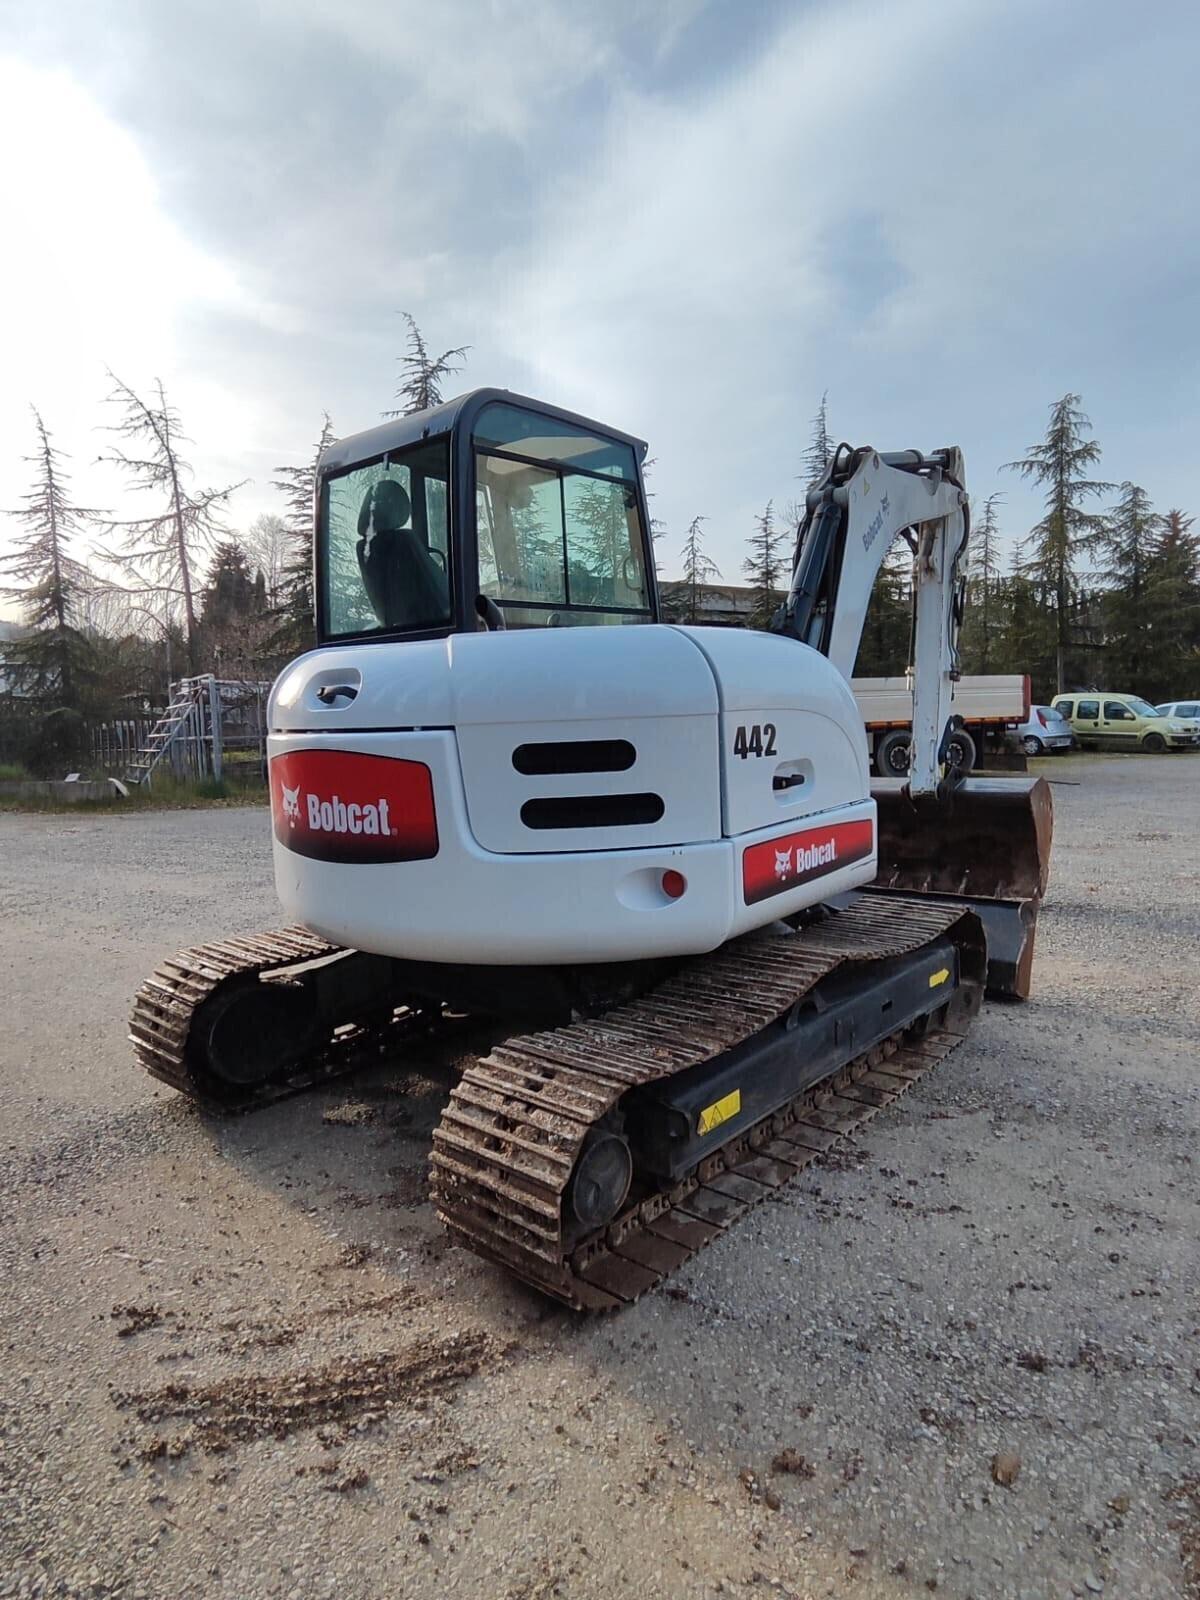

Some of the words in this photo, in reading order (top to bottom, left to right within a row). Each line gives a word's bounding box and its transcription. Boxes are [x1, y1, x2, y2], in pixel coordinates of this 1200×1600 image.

[733, 723, 777, 760] 442
[306, 793, 391, 836] Bobcat
[796, 838, 836, 874] Bobcat
